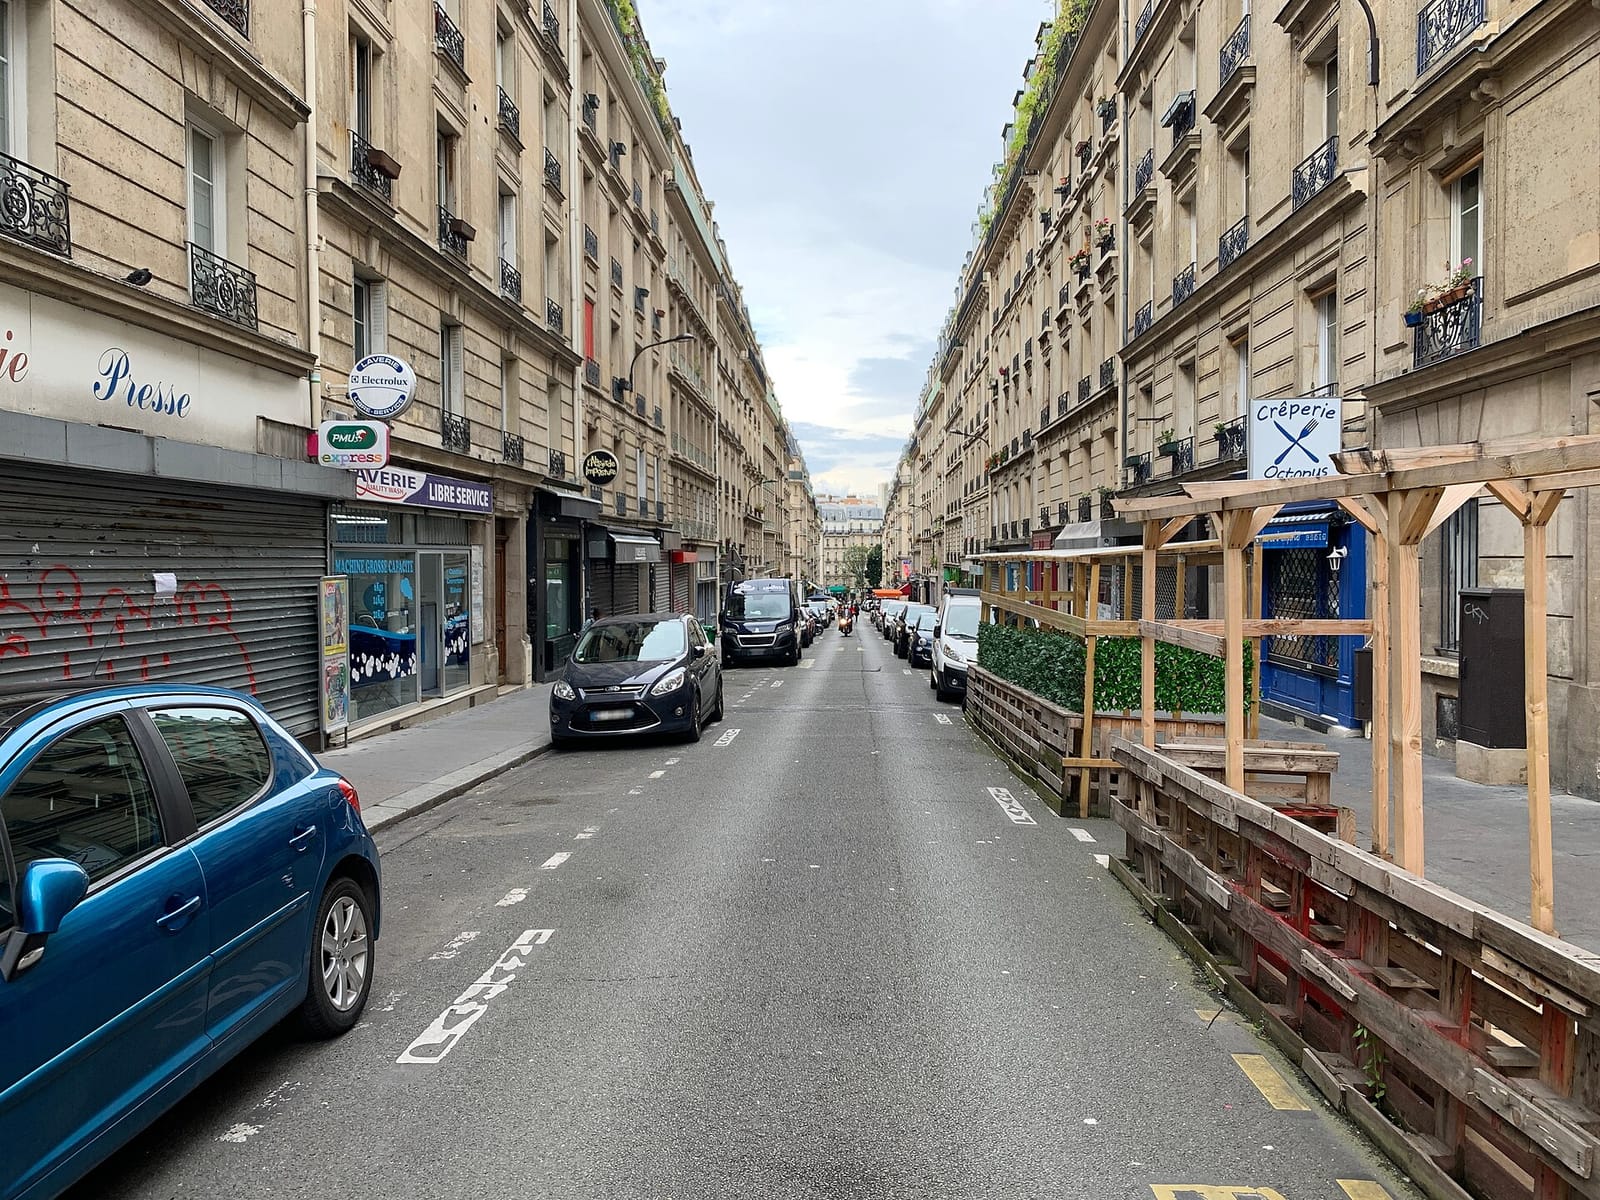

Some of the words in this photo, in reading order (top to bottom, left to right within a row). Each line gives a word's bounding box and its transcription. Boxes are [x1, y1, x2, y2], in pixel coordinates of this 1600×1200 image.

[360, 356, 400, 370] LAVERIE
[93, 347, 191, 418] Presse
[362, 375, 408, 386] Electrolux
[1257, 401, 1336, 421] Crêperie
[332, 433, 355, 443] PMU
[322, 453, 383, 466] express
[356, 468, 417, 490] AVERIE
[429, 482, 455, 504] LIBRE
[456, 486, 489, 507] SERVICE
[335, 559, 365, 574] MACHINE
[365, 559, 388, 574] GROSSE
